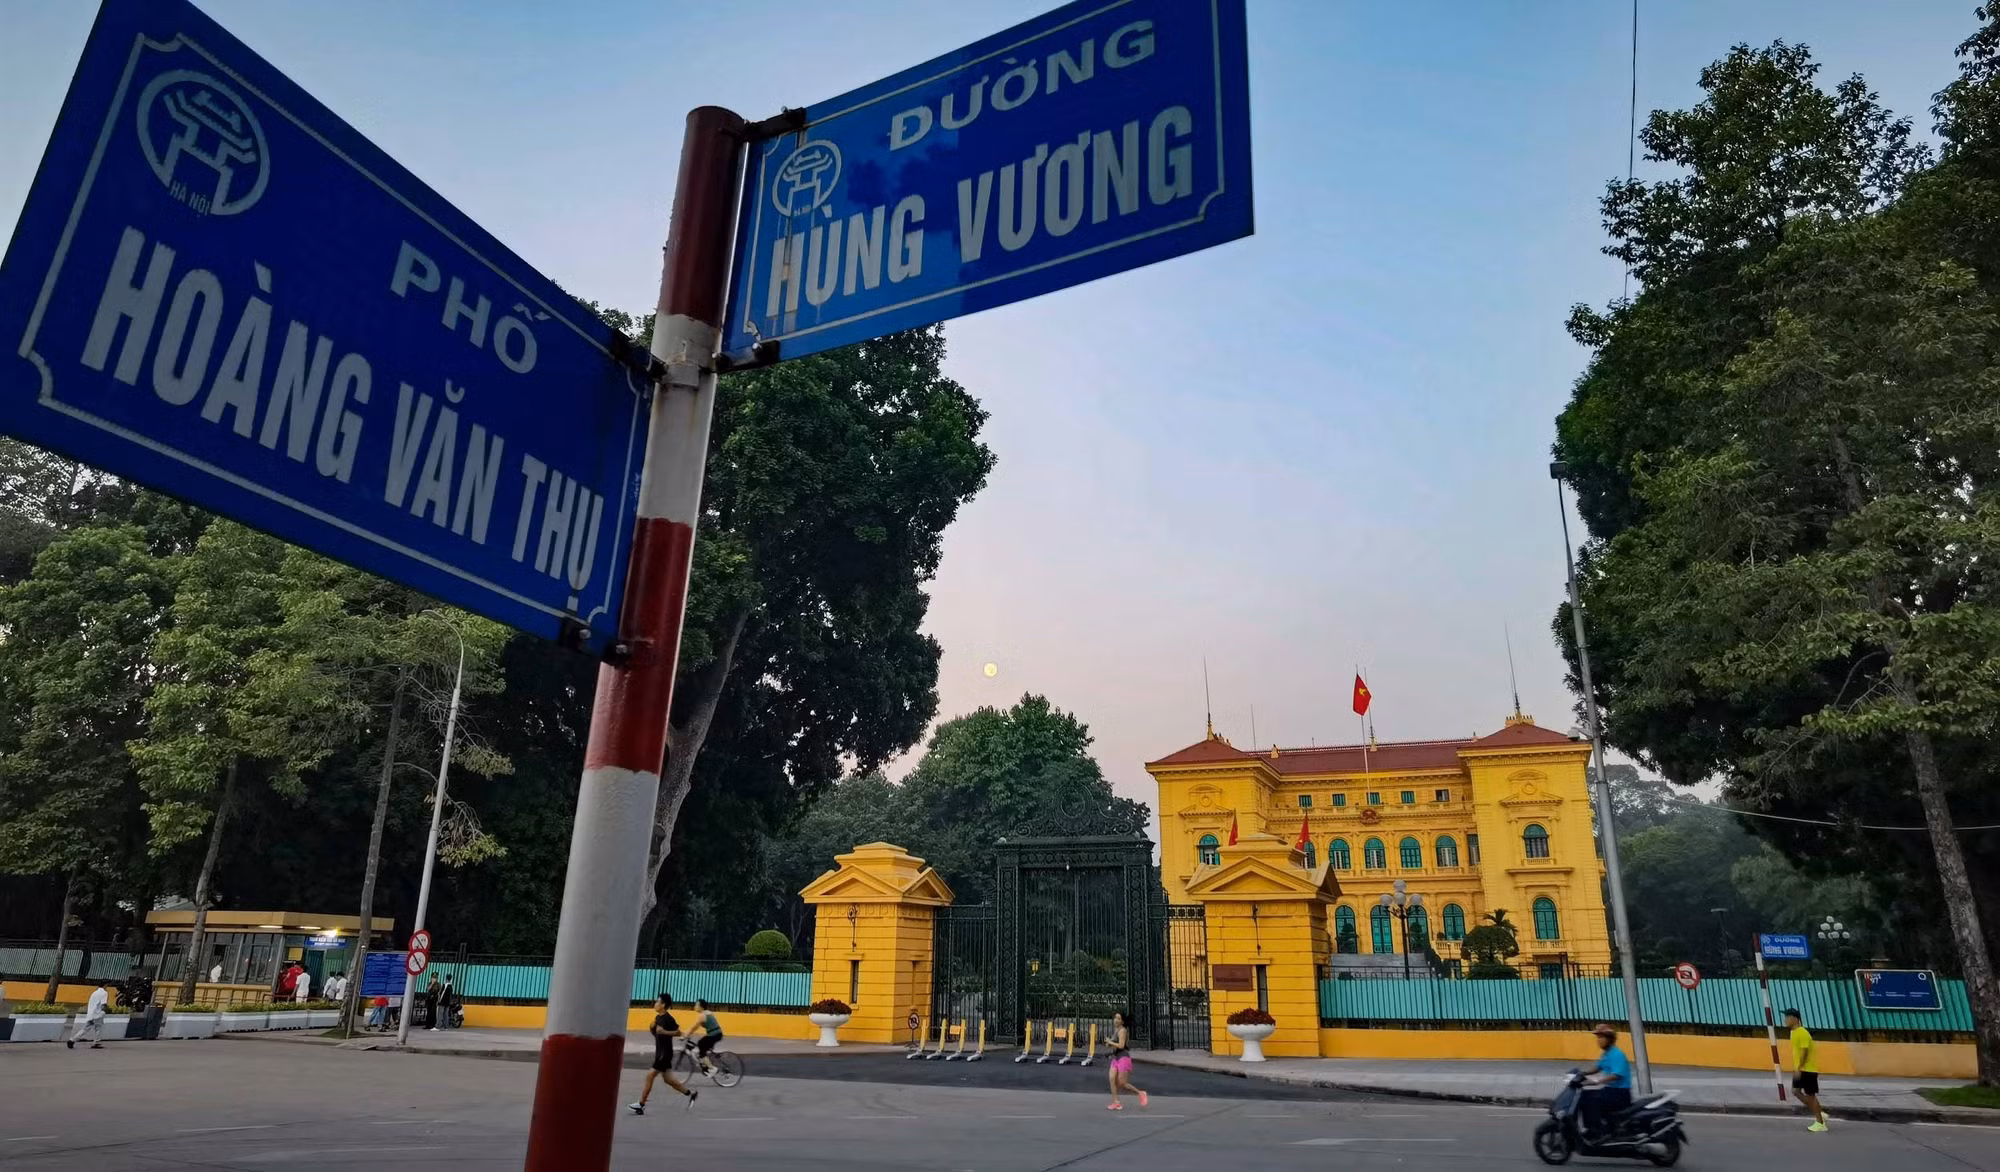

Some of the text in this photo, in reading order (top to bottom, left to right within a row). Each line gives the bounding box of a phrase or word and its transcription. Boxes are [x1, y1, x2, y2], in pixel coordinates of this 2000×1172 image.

[886, 20, 1155, 151] ĐƯỜNG
[170, 180, 187, 203] HÀ
[766, 105, 1193, 318] HÙNG VƯƠNG
[390, 240, 551, 375] PHỐ
[80, 225, 604, 611] HOÀNG VĂN THỤ
